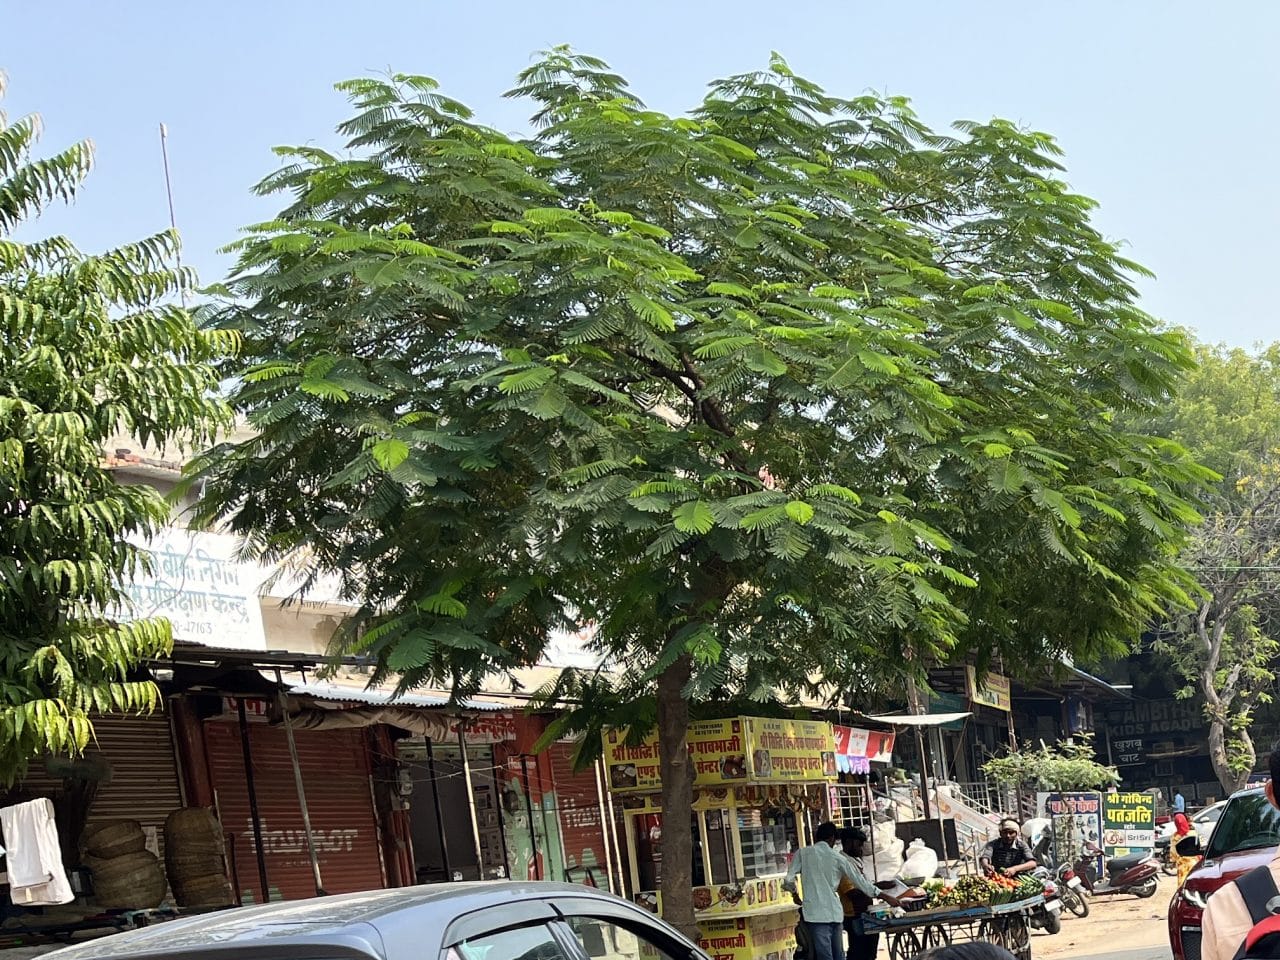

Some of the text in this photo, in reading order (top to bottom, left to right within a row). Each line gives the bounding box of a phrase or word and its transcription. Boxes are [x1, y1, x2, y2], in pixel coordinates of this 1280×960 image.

[1110, 724, 1144, 737] KIDS
[612, 745, 626, 761] श्री
[696, 736, 741, 754] पावभाजी
[1107, 793, 1152, 804] श्री गोविन्द
[1107, 805, 1152, 823] पतंजलि
